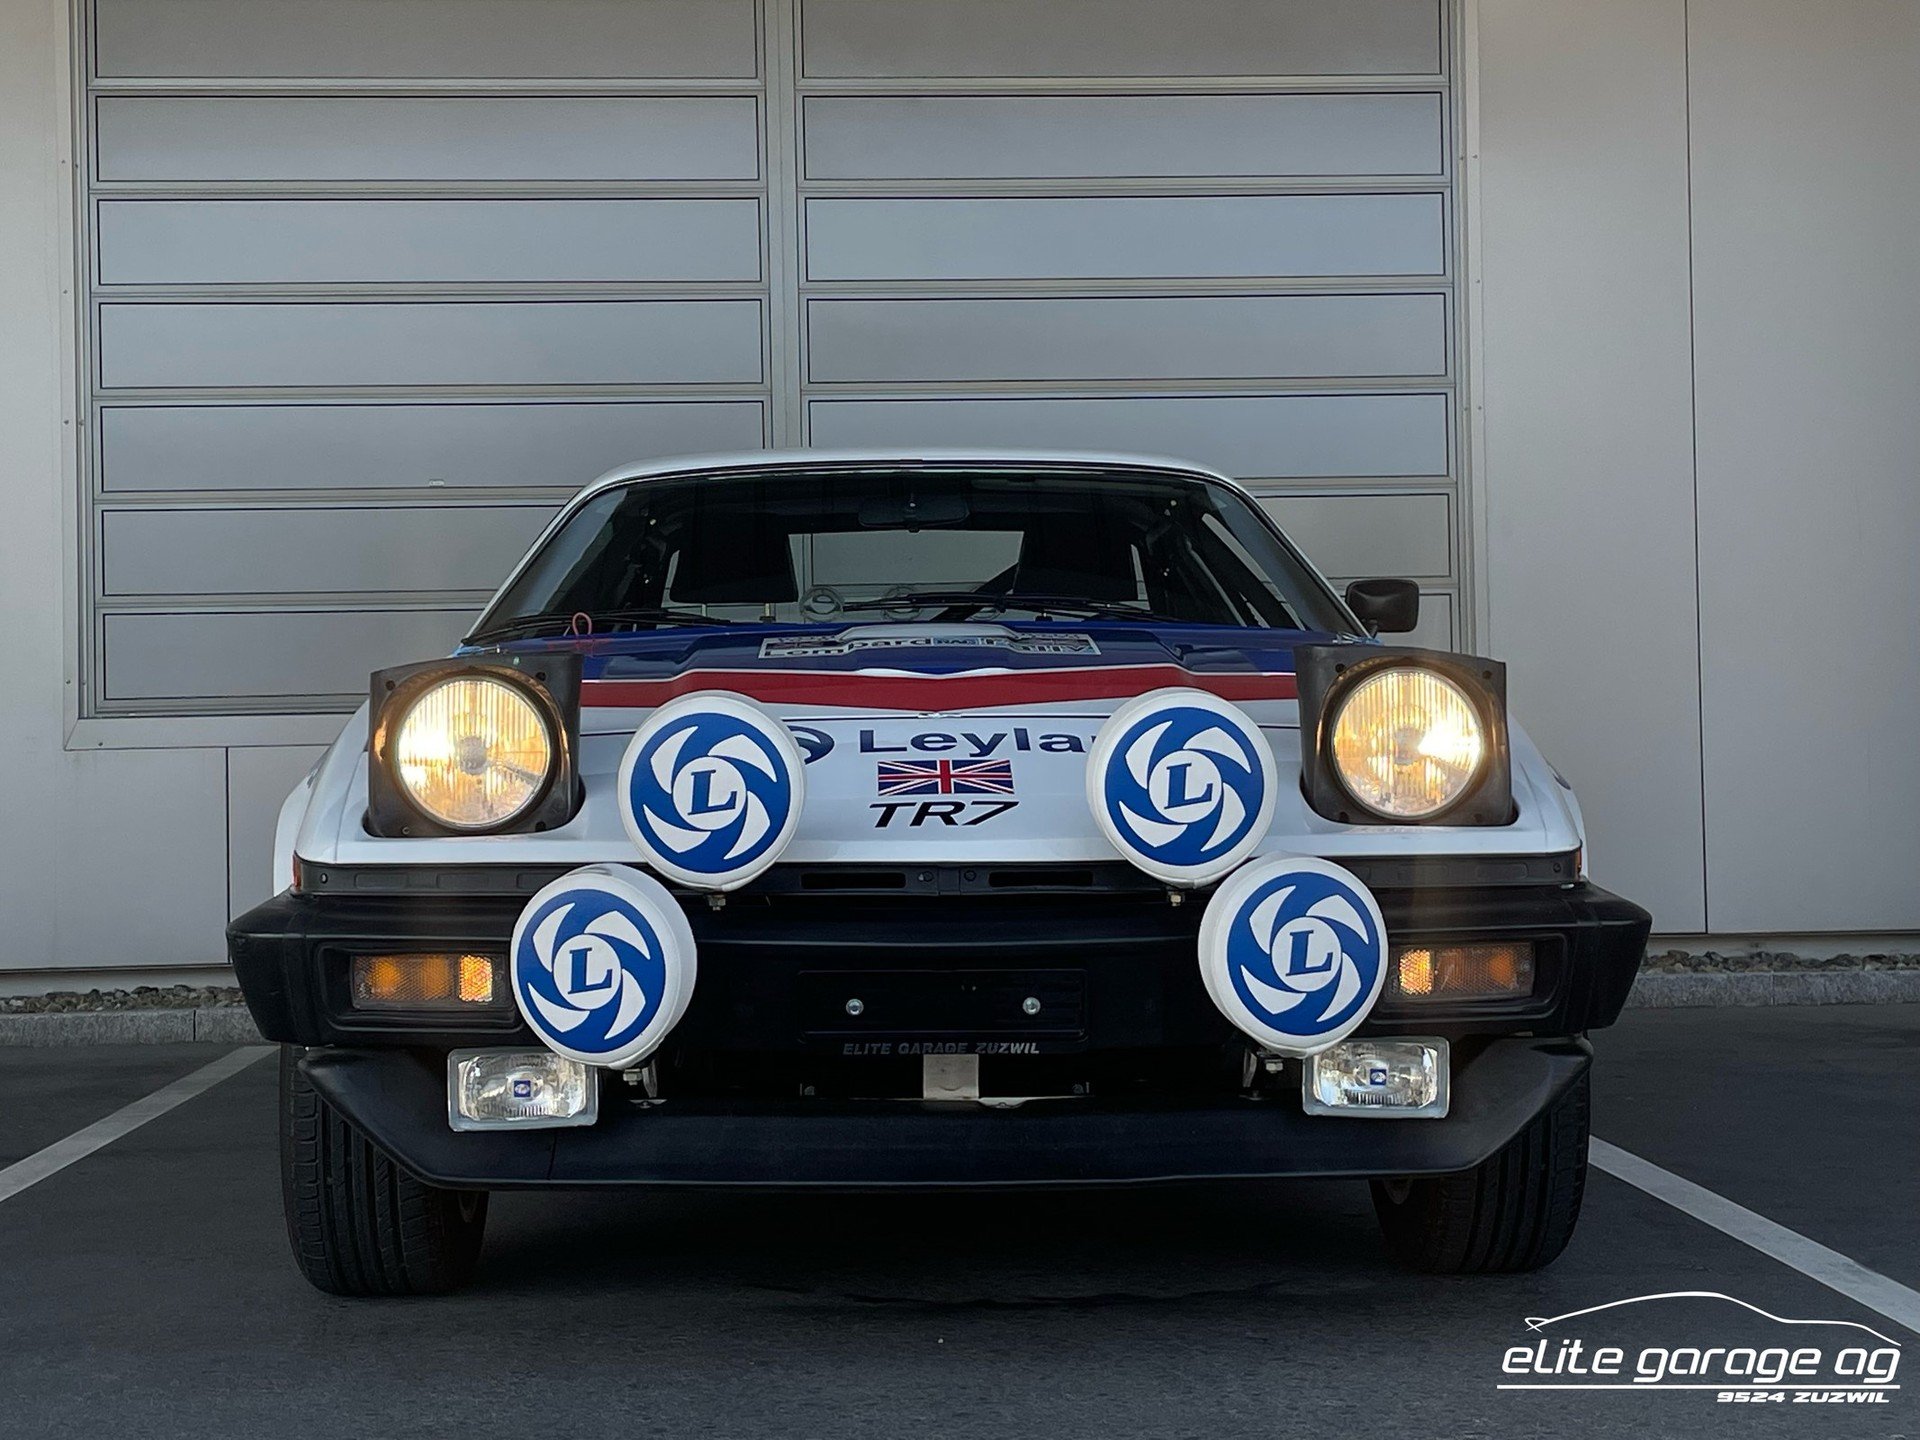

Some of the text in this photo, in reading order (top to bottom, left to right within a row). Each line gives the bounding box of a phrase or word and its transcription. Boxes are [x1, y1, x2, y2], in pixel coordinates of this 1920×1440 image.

[860, 728, 1095, 757] Leyla
[687, 769, 737, 815] L
[1164, 763, 1213, 809] L
[869, 801, 1020, 828] TR7
[567, 947, 613, 994] L
[1285, 930, 1333, 976] L
[843, 1042, 1040, 1054] ELITE GARAGE ZUZWIL
